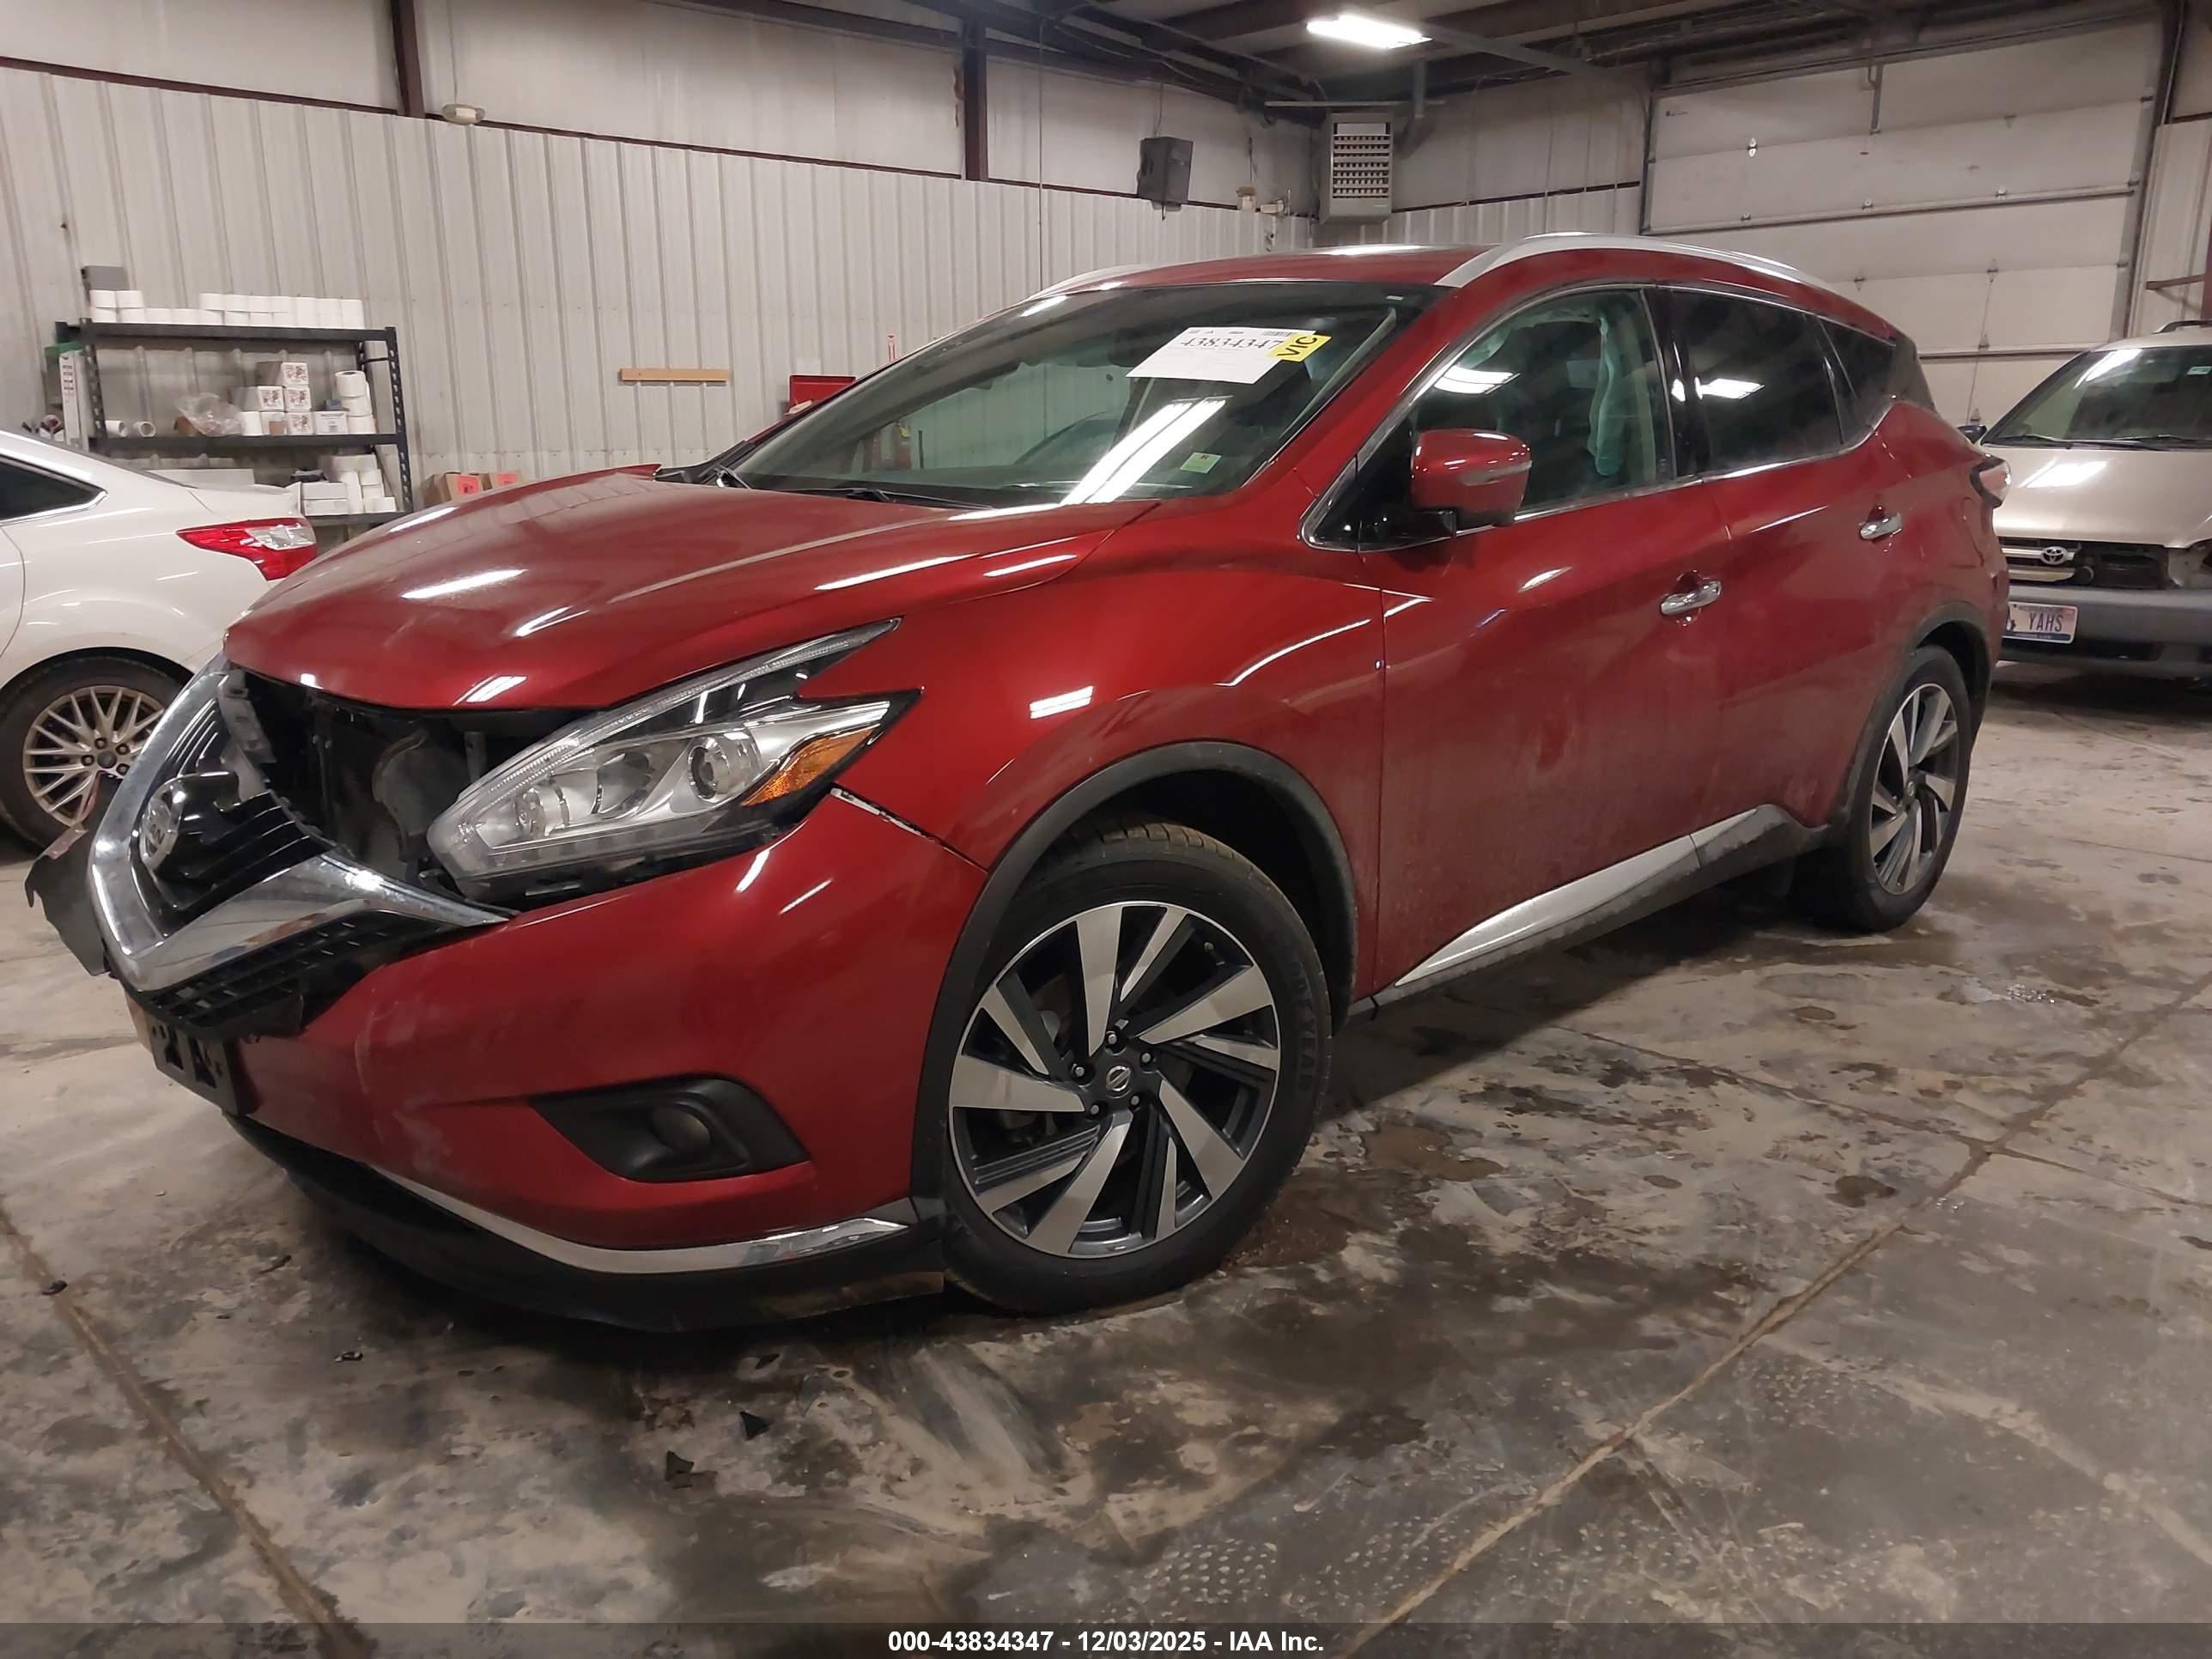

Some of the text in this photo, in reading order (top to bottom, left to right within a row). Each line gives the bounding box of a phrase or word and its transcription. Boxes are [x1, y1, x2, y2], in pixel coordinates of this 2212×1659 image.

[1181, 337, 1284, 349] 43834347
[1277, 336, 1318, 357] VIC
[2028, 611, 2064, 632] YAHS
